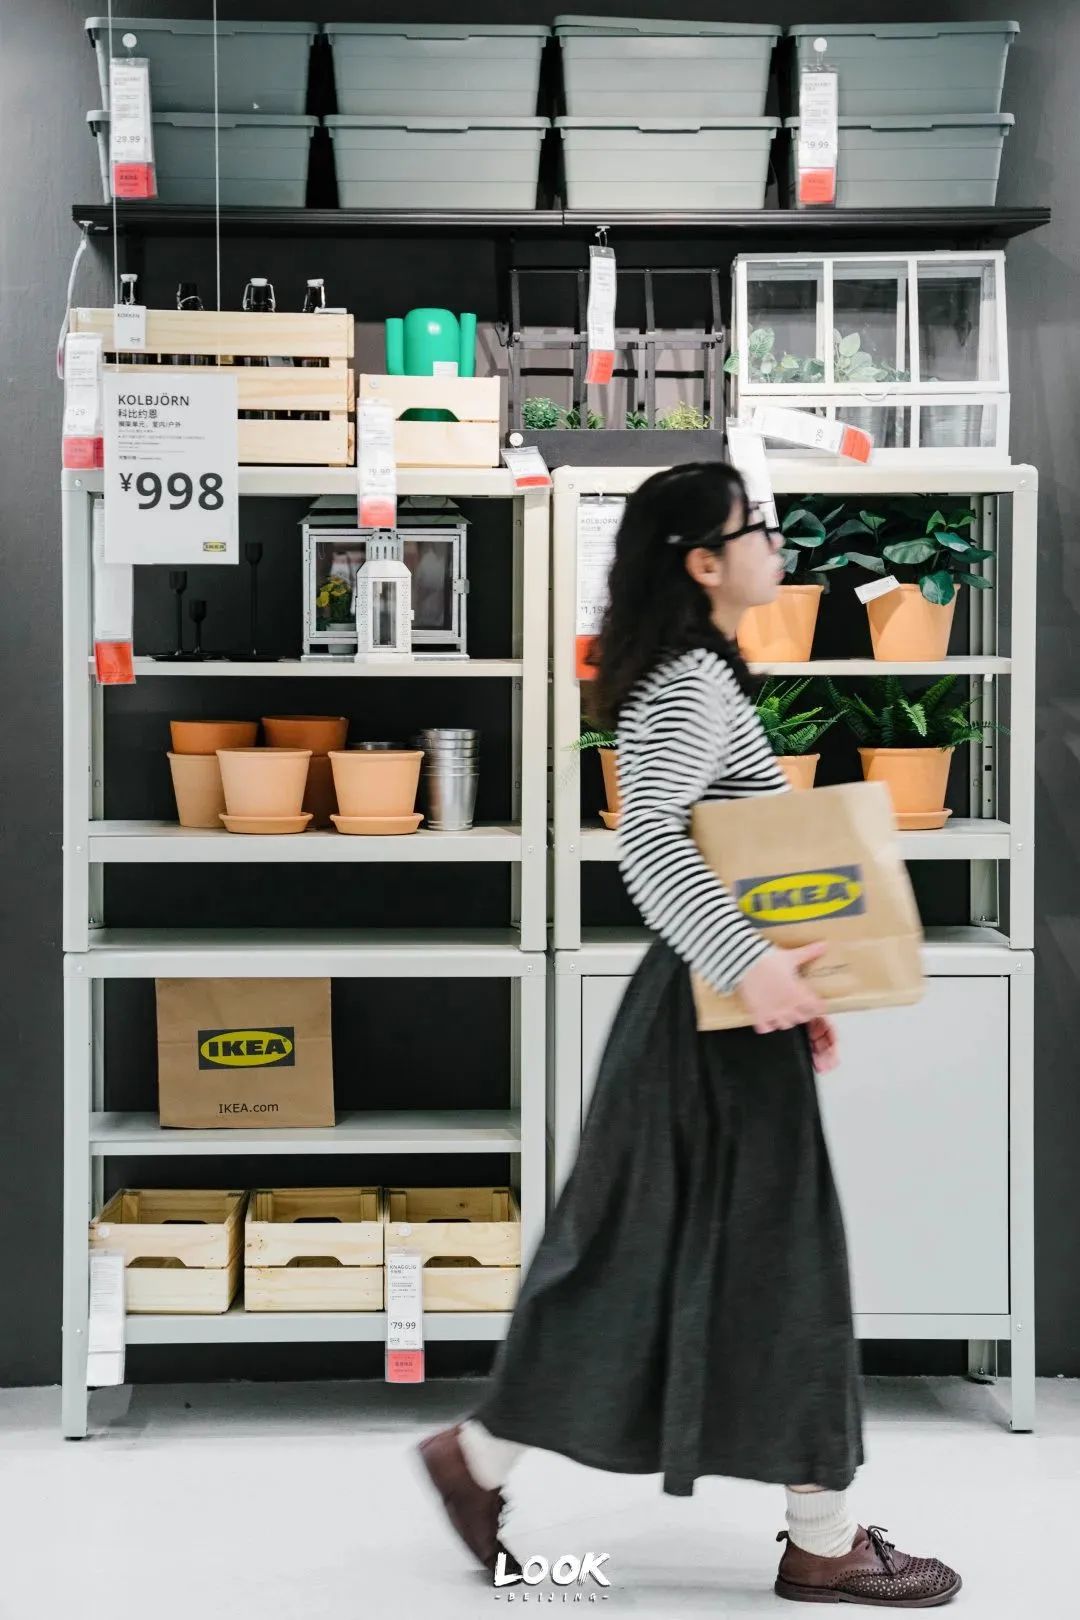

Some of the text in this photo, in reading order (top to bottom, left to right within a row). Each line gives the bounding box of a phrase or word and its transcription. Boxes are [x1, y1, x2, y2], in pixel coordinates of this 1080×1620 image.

[117, 392, 190, 406] KOLBJÖRN
[117, 408, 158, 419] 科比约恩
[119, 472, 224, 511] ¥998
[751, 882, 850, 912] IKEA
[208, 1038, 287, 1057] IKEA
[218, 1103, 279, 1113] IKEA.com
